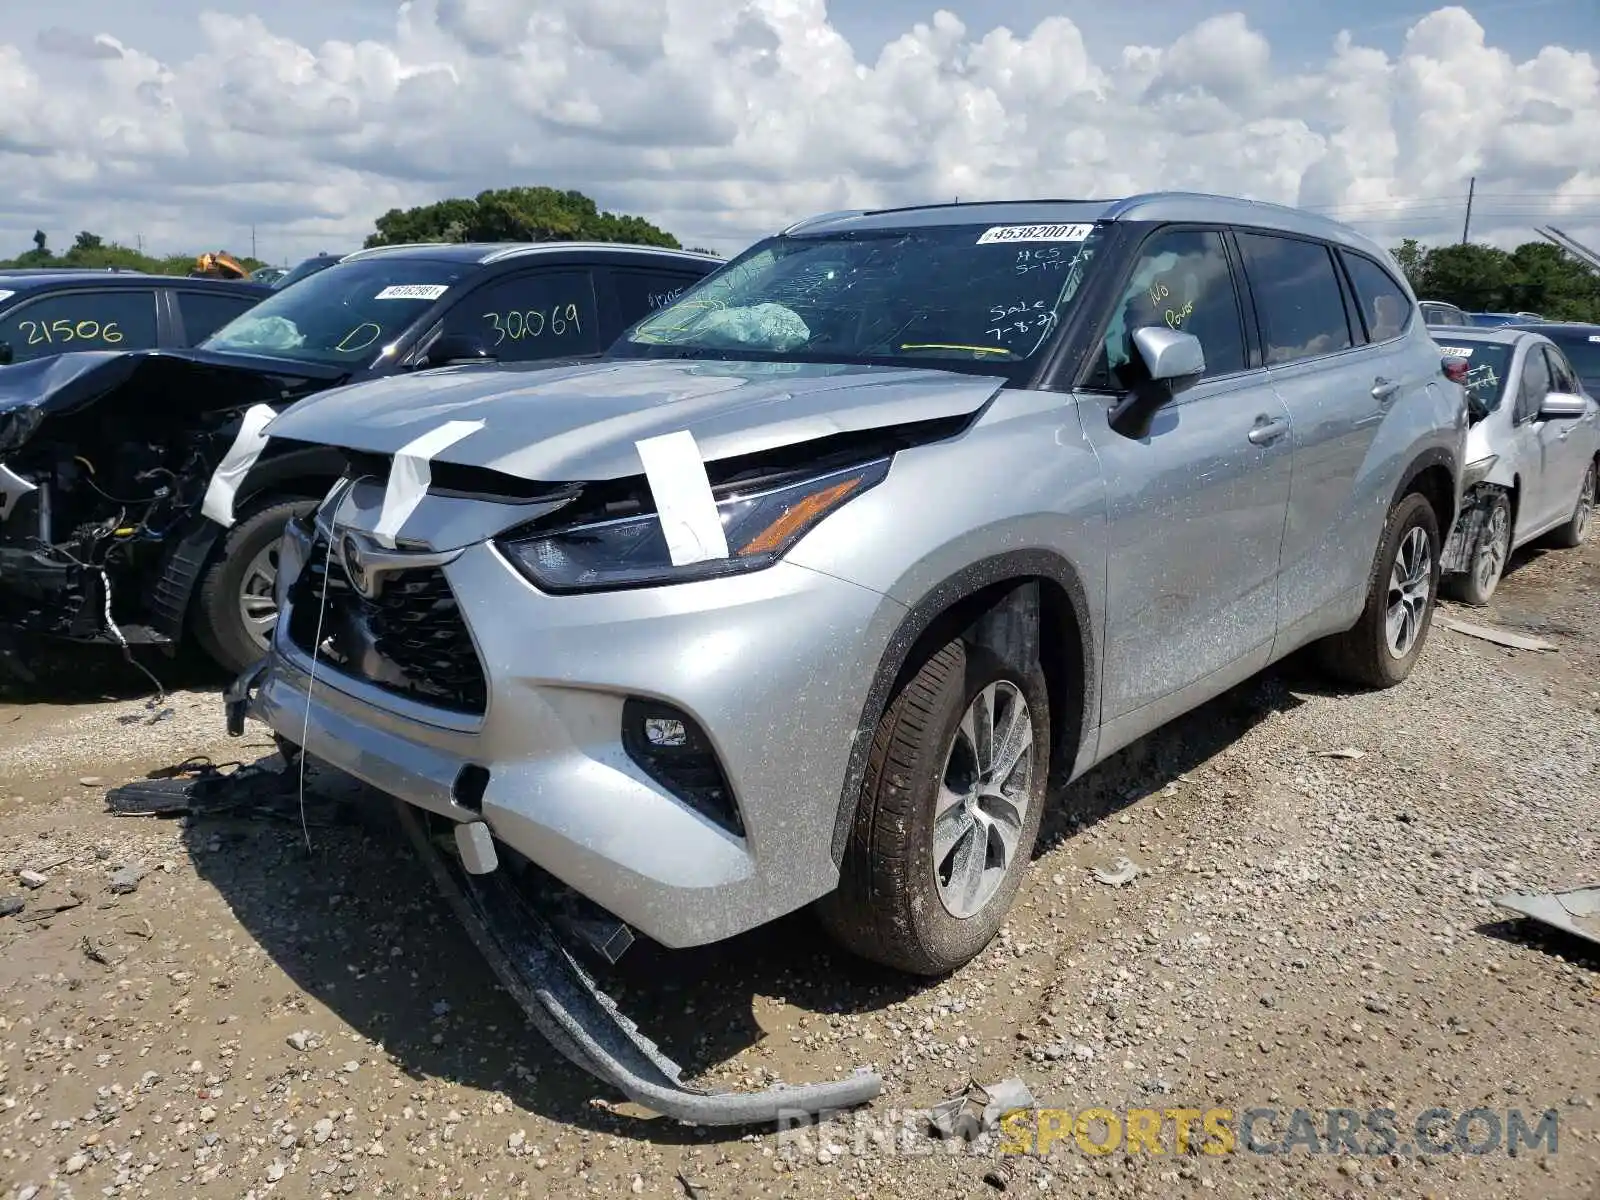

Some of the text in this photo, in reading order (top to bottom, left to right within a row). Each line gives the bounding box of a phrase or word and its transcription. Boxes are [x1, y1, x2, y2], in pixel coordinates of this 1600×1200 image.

[1149, 281, 1169, 307] No
[990, 301, 1046, 322] Sale
[19, 319, 124, 344] 21506
